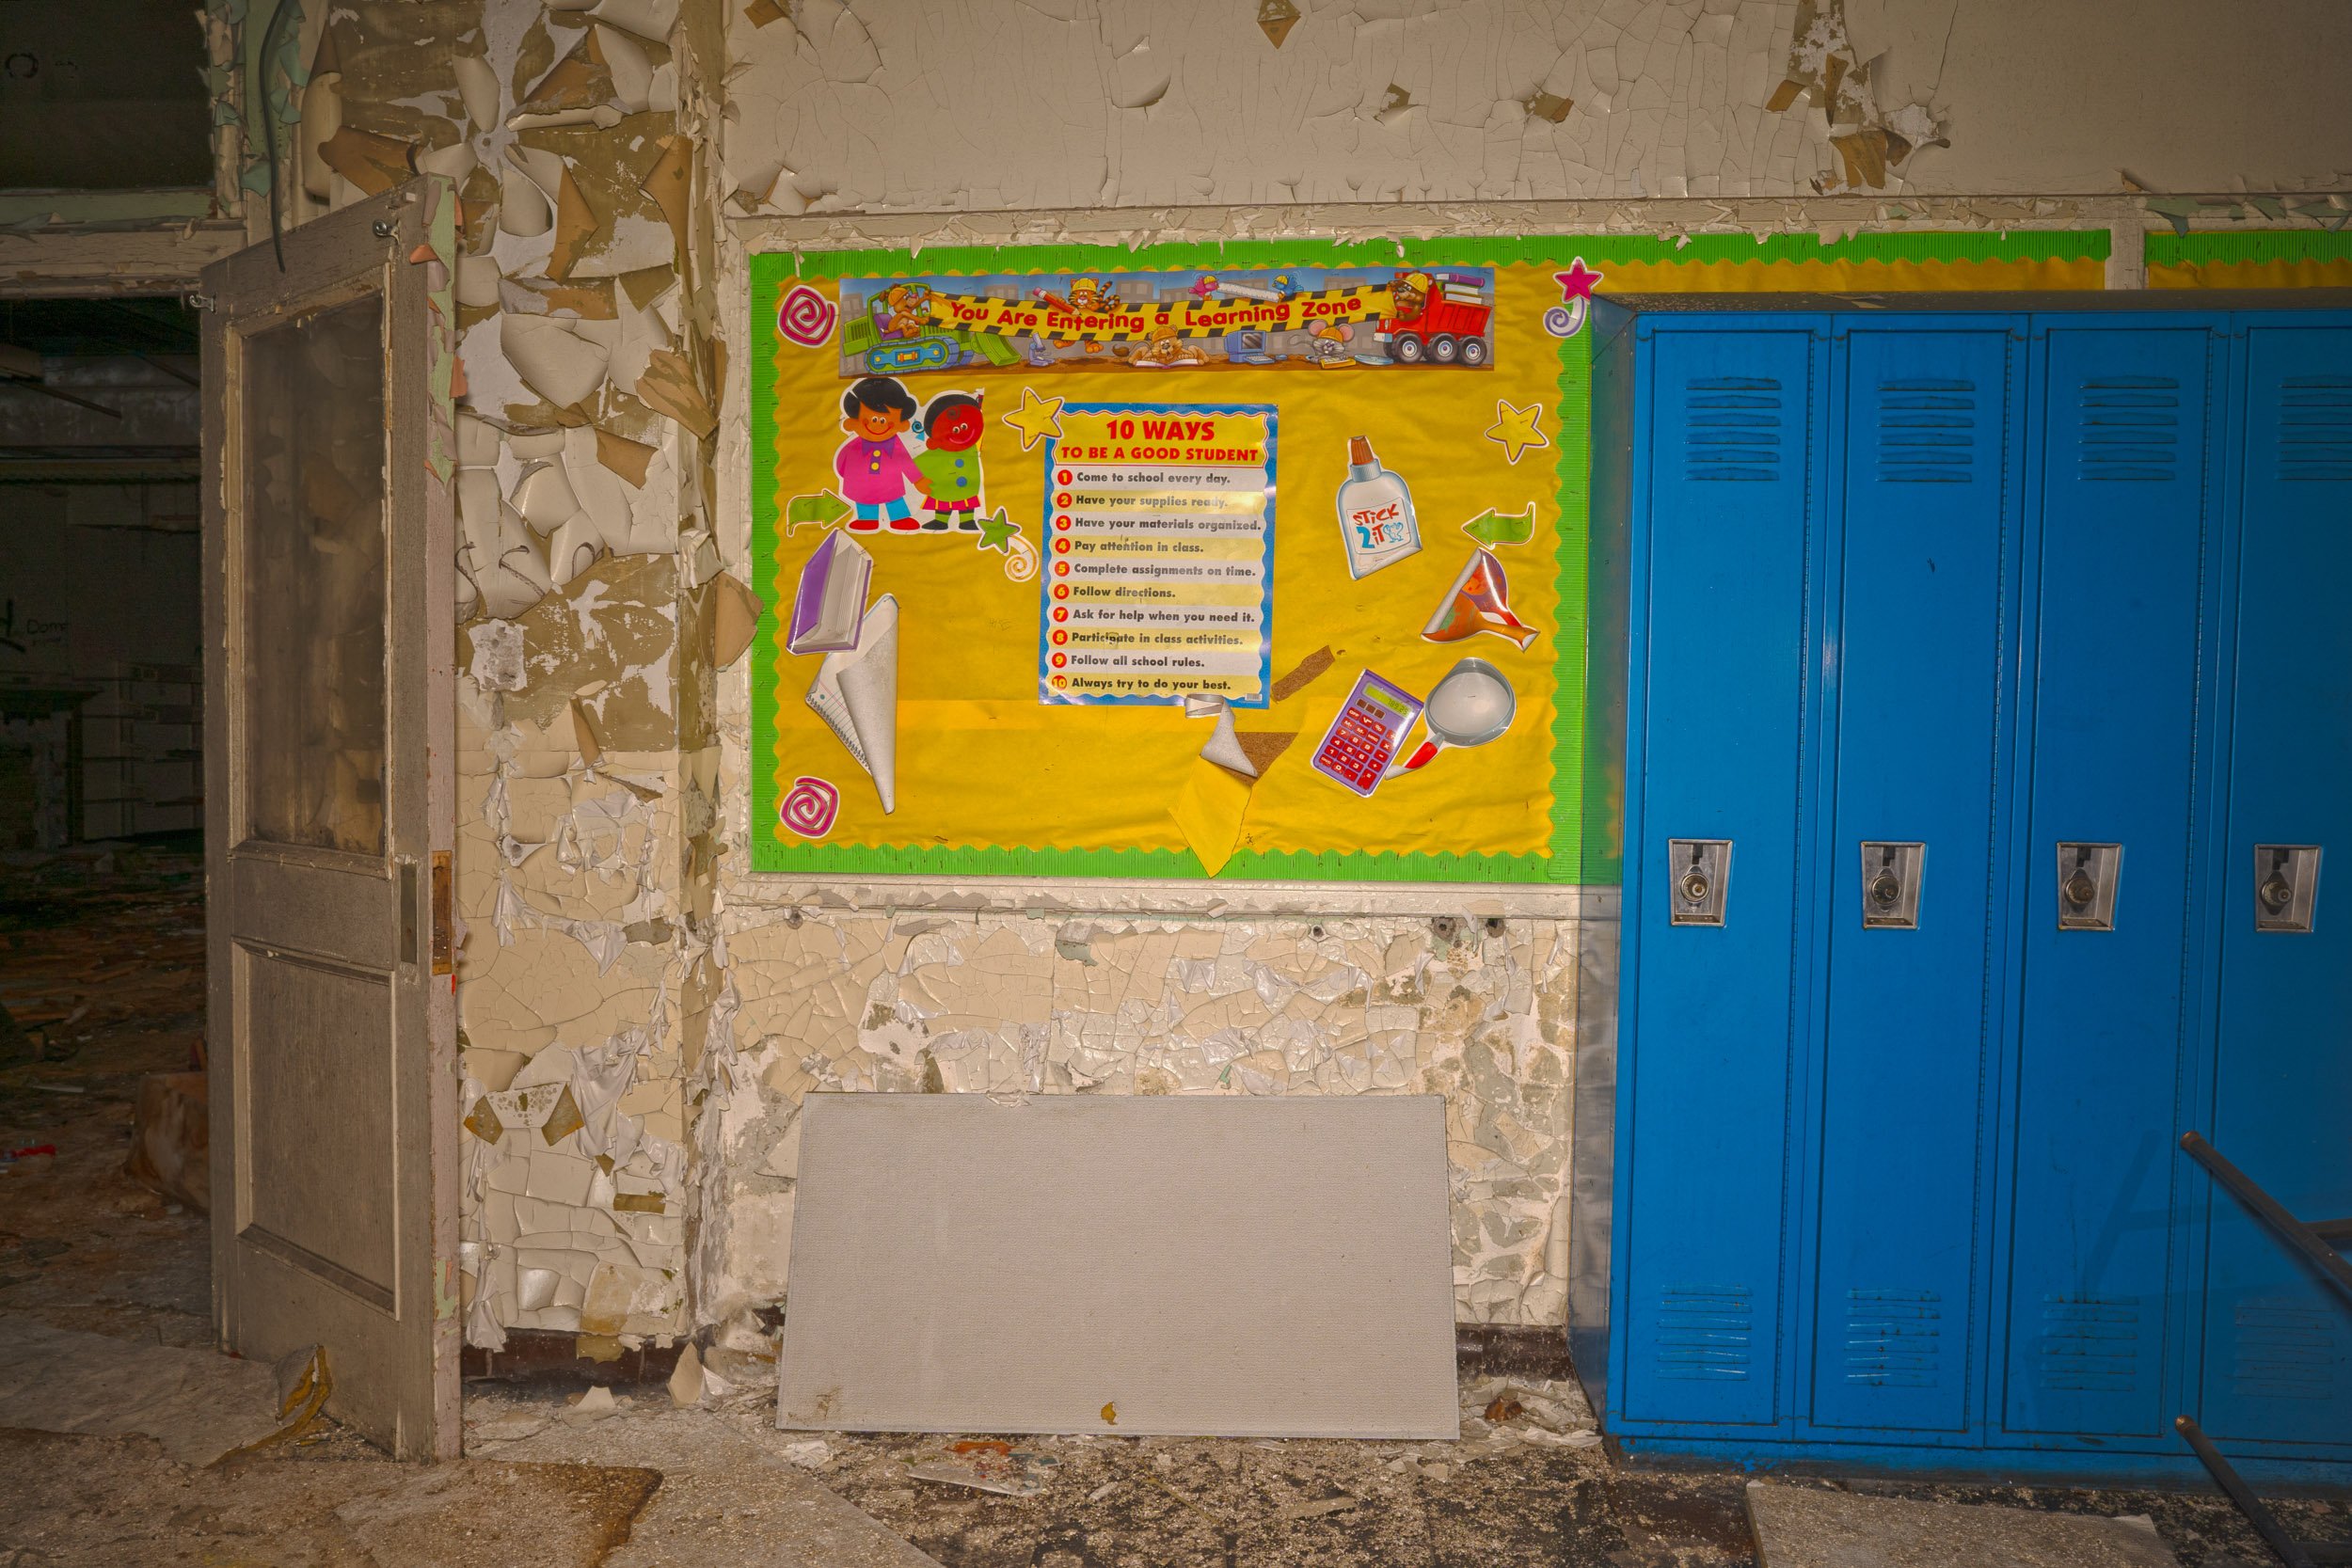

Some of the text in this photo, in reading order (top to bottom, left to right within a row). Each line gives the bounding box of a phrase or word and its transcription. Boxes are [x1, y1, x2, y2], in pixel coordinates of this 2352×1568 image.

[950, 297, 1361, 333] You Are Entering a Learning Zone
[1106, 420, 1215, 441] 10 WAYS
[1061, 447, 1258, 461] TO BE A GOOD STUDENT
[1077, 472, 1107, 482] Come
[1112, 473, 1123, 482] to
[1128, 472, 1164, 483] school
[1168, 474, 1201, 485] every
[1206, 473, 1231, 484] day.
[1060, 495, 1069, 505] 2
[1076, 496, 1104, 504] Have
[1110, 498, 1136, 507] your
[1139, 497, 1187, 508] supplies
[1060, 517, 1261, 531] 3 Have your materials organized.
[1357, 527, 1375, 548] 2
[1058, 540, 1203, 552] 4 Pay attention in class.
[1057, 563, 1256, 577] 5 Complete assignments on time.
[1057, 587, 1176, 597] 6 Follow directions.
[1057, 610, 1254, 623] 7 Ask for help when you need it.
[1056, 632, 1243, 645] 8 Participate in class activities.
[1055, 656, 1204, 667] 9 Follow all school rules.
[1053, 678, 1066, 688] 10
[1072, 679, 1112, 689] Always
[1118, 680, 1134, 689] try
[1154, 679, 1168, 689] do
[1172, 682, 1199, 691] your
[1203, 680, 1231, 689] best.
